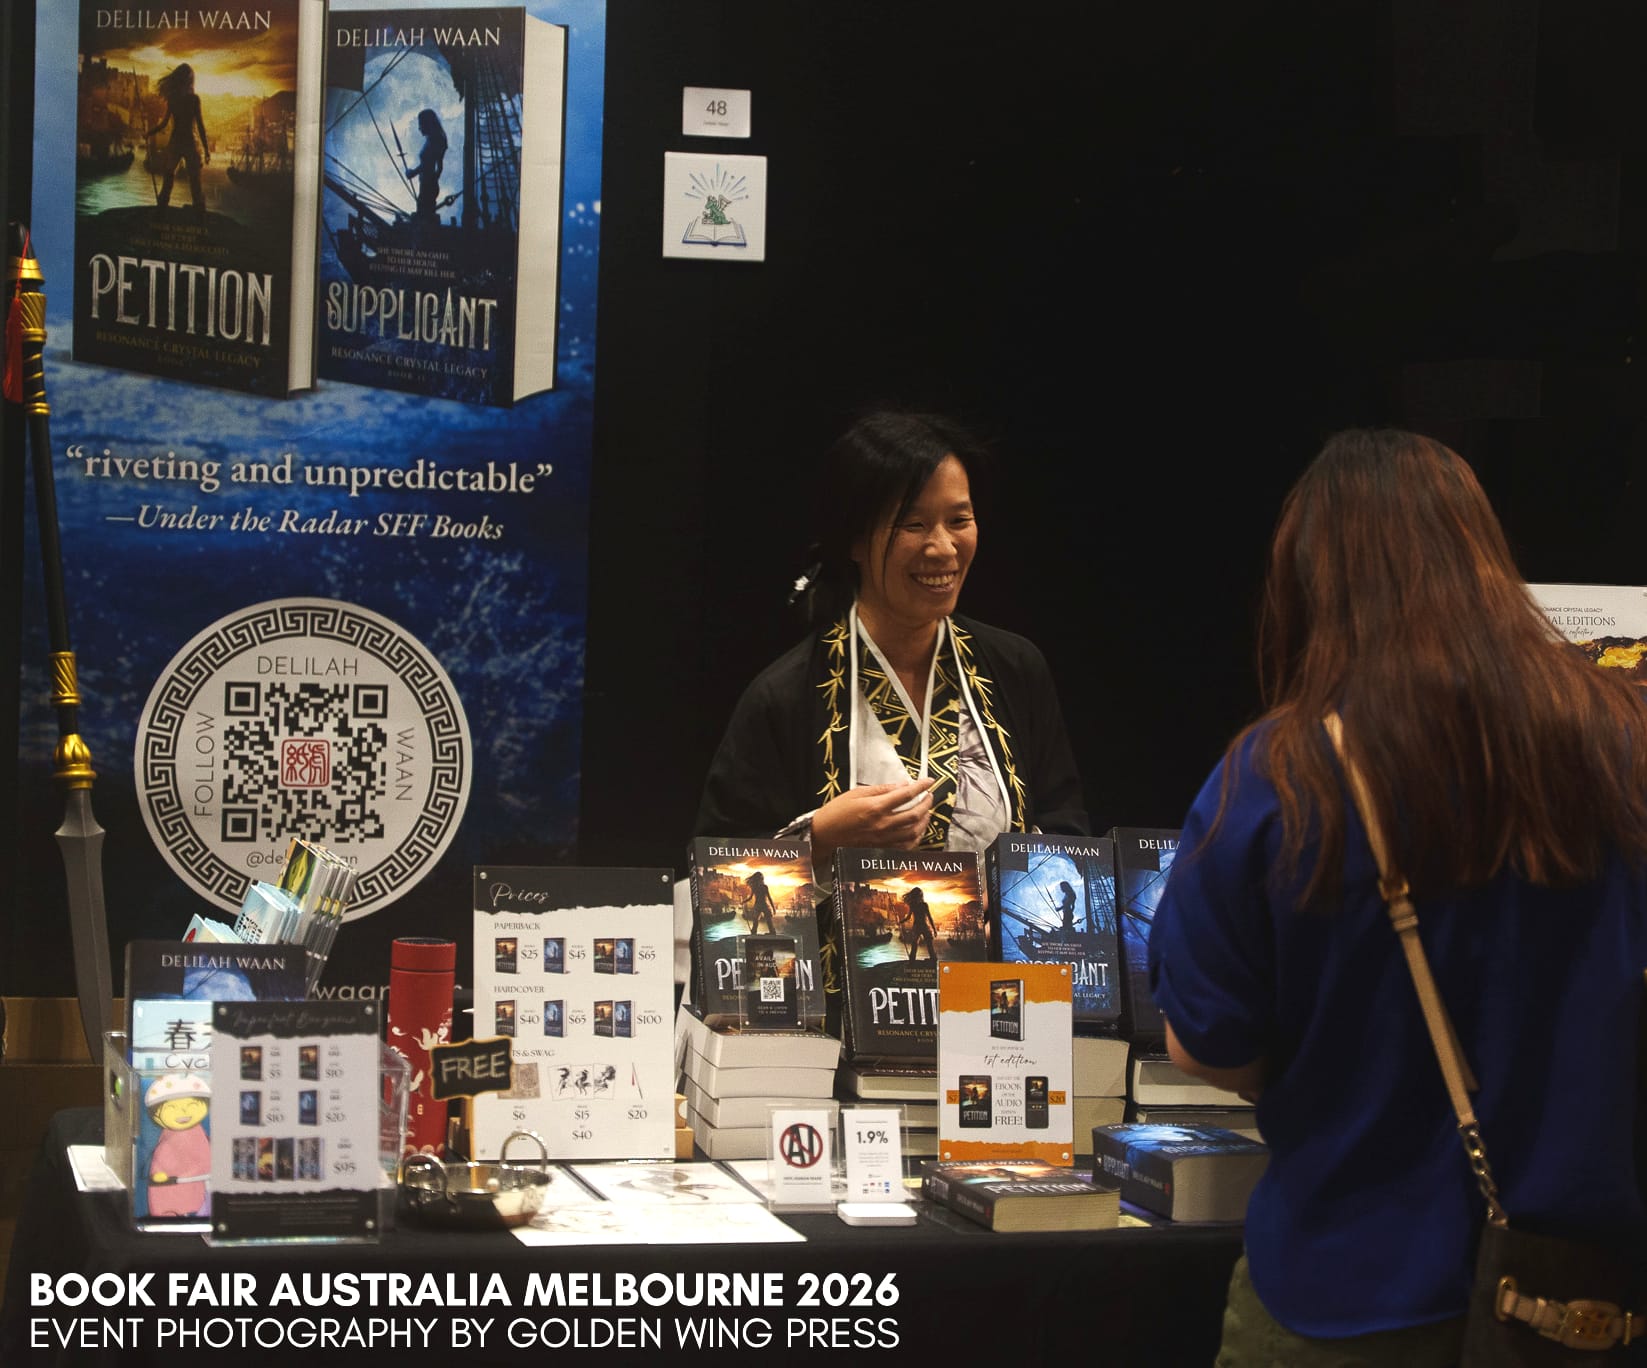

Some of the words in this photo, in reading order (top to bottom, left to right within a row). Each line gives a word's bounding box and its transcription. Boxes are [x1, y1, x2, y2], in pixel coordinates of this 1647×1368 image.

[96, 10, 189, 29] DELILAH
[199, 10, 271, 30] WAAN
[336, 27, 424, 47] DELILAH
[433, 27, 500, 47] WAAN
[706, 100, 727, 116] 48
[89, 253, 273, 346] PETITION
[326, 280, 498, 351] SUPPLICANT
[331, 346, 393, 366] RESONANCE
[395, 355, 444, 373] CRYSTAL
[447, 363, 488, 379] LEGACY
[66, 444, 221, 492] “riveting
[231, 453, 293, 484] and
[304, 459, 553, 498] unpredictable”
[230, 509, 271, 533] the
[278, 512, 368, 537] Radar
[373, 513, 430, 538] SFF
[431, 514, 504, 541] Books
[1566, 616, 1616, 627] EDITIONS
[257, 656, 358, 676] DELILAH
[194, 711, 215, 817] FOLLOW
[394, 726, 415, 801] WAAN
[1011, 843, 1062, 855] DELILAH
[1064, 845, 1100, 857] WAAN
[1139, 838, 1180, 850] DELIL
[708, 846, 759, 858] DELILAH
[763, 847, 799, 859] WAAN
[861, 858, 918, 871] DELILAH
[922, 860, 964, 873] WAAN
[489, 882, 550, 907] Prices
[494, 922, 541, 930] PAPERBACK
[161, 954, 231, 969] DELILAH
[236, 955, 286, 970] WAAN
[520, 949, 539, 960] $25
[568, 949, 587, 960] $45
[638, 950, 656, 961] $65
[494, 985, 545, 994] HARDCOVER
[868, 987, 938, 1026] PETIT
[519, 1014, 540, 1025] $40
[568, 1014, 587, 1025] $65
[636, 1014, 662, 1025] $100
[877, 1029, 918, 1037] RESONANCE
[992, 1020, 1019, 1034] PETITION
[530, 1050, 555, 1058] SWAG
[440, 1051, 506, 1084] FREE
[984, 1054, 997, 1066] 1st
[1000, 1054, 1038, 1069] edition
[995, 1082, 1022, 1091] EBOOK
[996, 1098, 1023, 1108] AUDIO
[512, 1110, 526, 1121] $6
[574, 1109, 590, 1120] $15
[627, 1109, 648, 1120] $20
[963, 1110, 988, 1121] PETITION
[995, 1115, 1023, 1126] FREE!
[572, 1129, 593, 1140] $40
[856, 1131, 889, 1144] 1.9%
[984, 1182, 1097, 1194] PETITION
